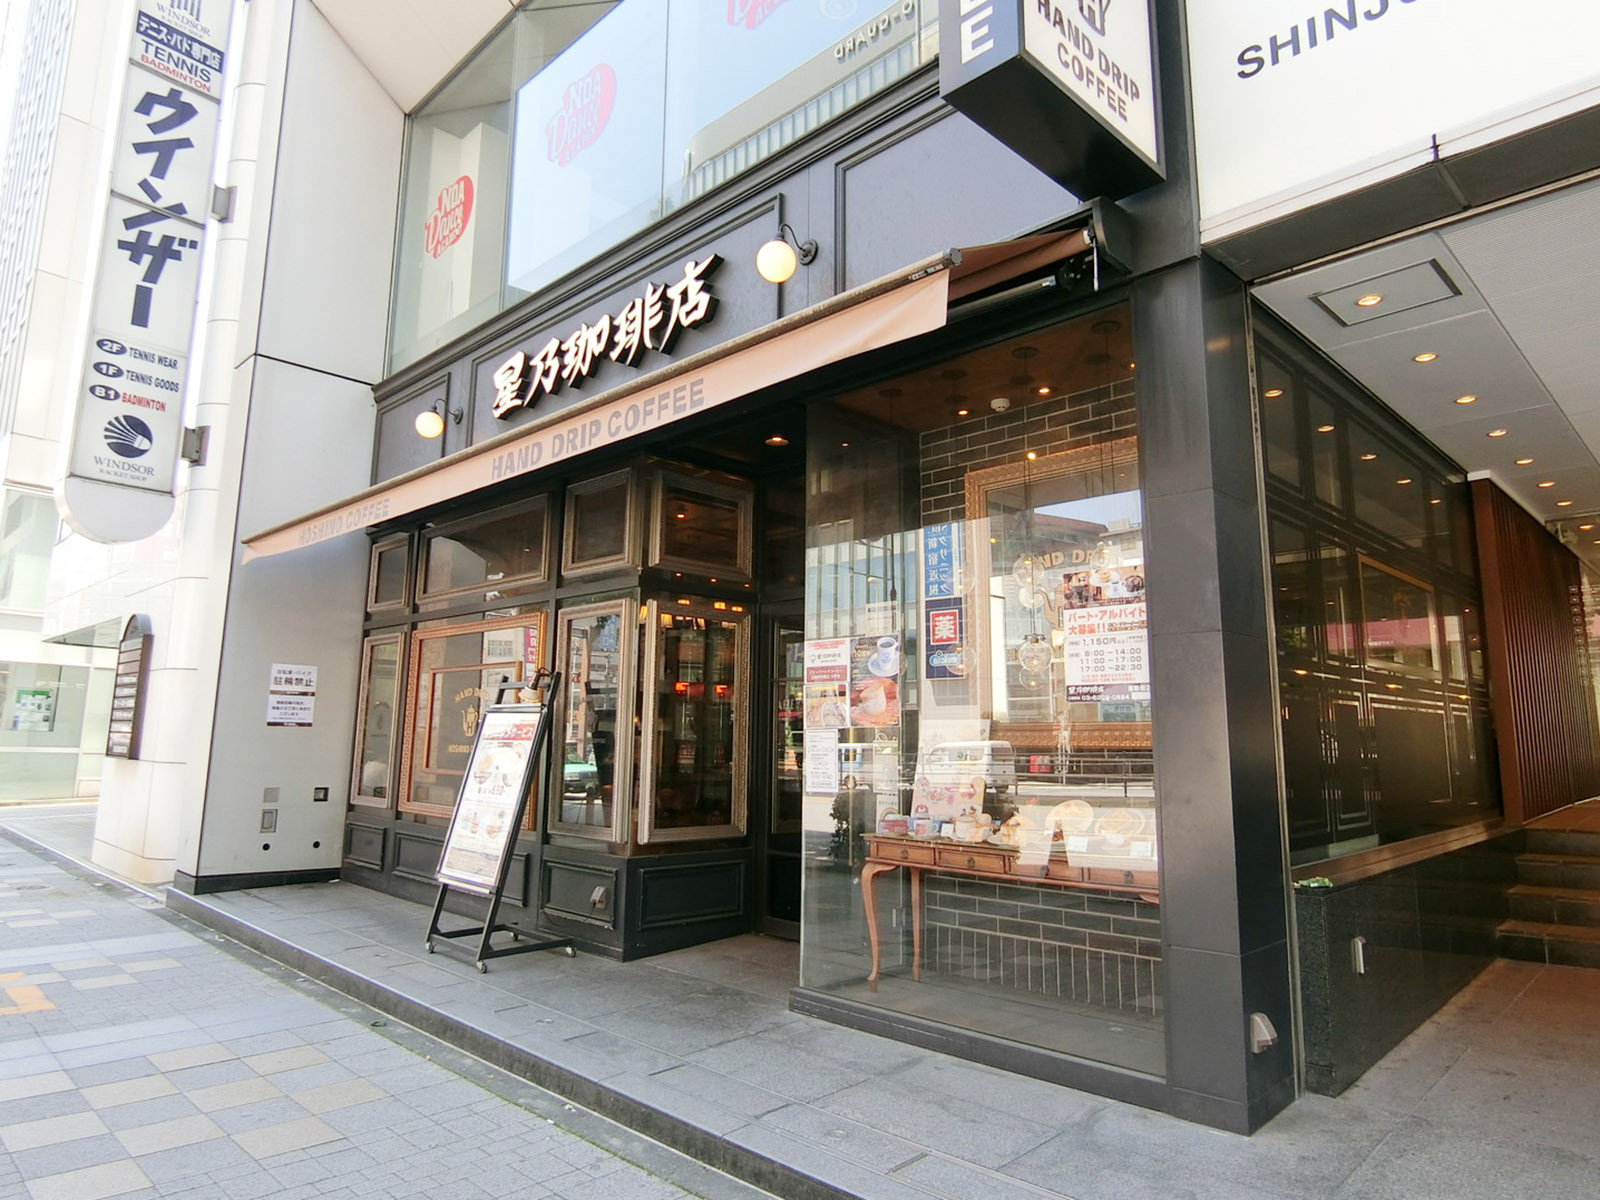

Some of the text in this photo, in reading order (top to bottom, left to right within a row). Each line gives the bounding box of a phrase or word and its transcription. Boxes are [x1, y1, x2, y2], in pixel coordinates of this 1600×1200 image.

[156, 2, 212, 37] WINDSOR
[141, 39, 211, 83] TENNIS
[1037, 0, 1141, 102] HAND DRIP
[141, 54, 211, 93] BADMINTON
[1057, 41, 1128, 122] COFFEE
[101, 340, 178, 370] 2F TENNIS WEAR
[492, 253, 722, 419] 星乃珈琲店
[99, 364, 180, 393] 1F TENNIS GOODS
[94, 387, 167, 412] B1 BADMINTON
[491, 378, 705, 481] HAND DRIP COFFEE
[93, 455, 155, 476] WINDSOR
[299, 498, 390, 546] HOSHINO COFFEE
[273, 676, 314, 687] 駐輪禁止
